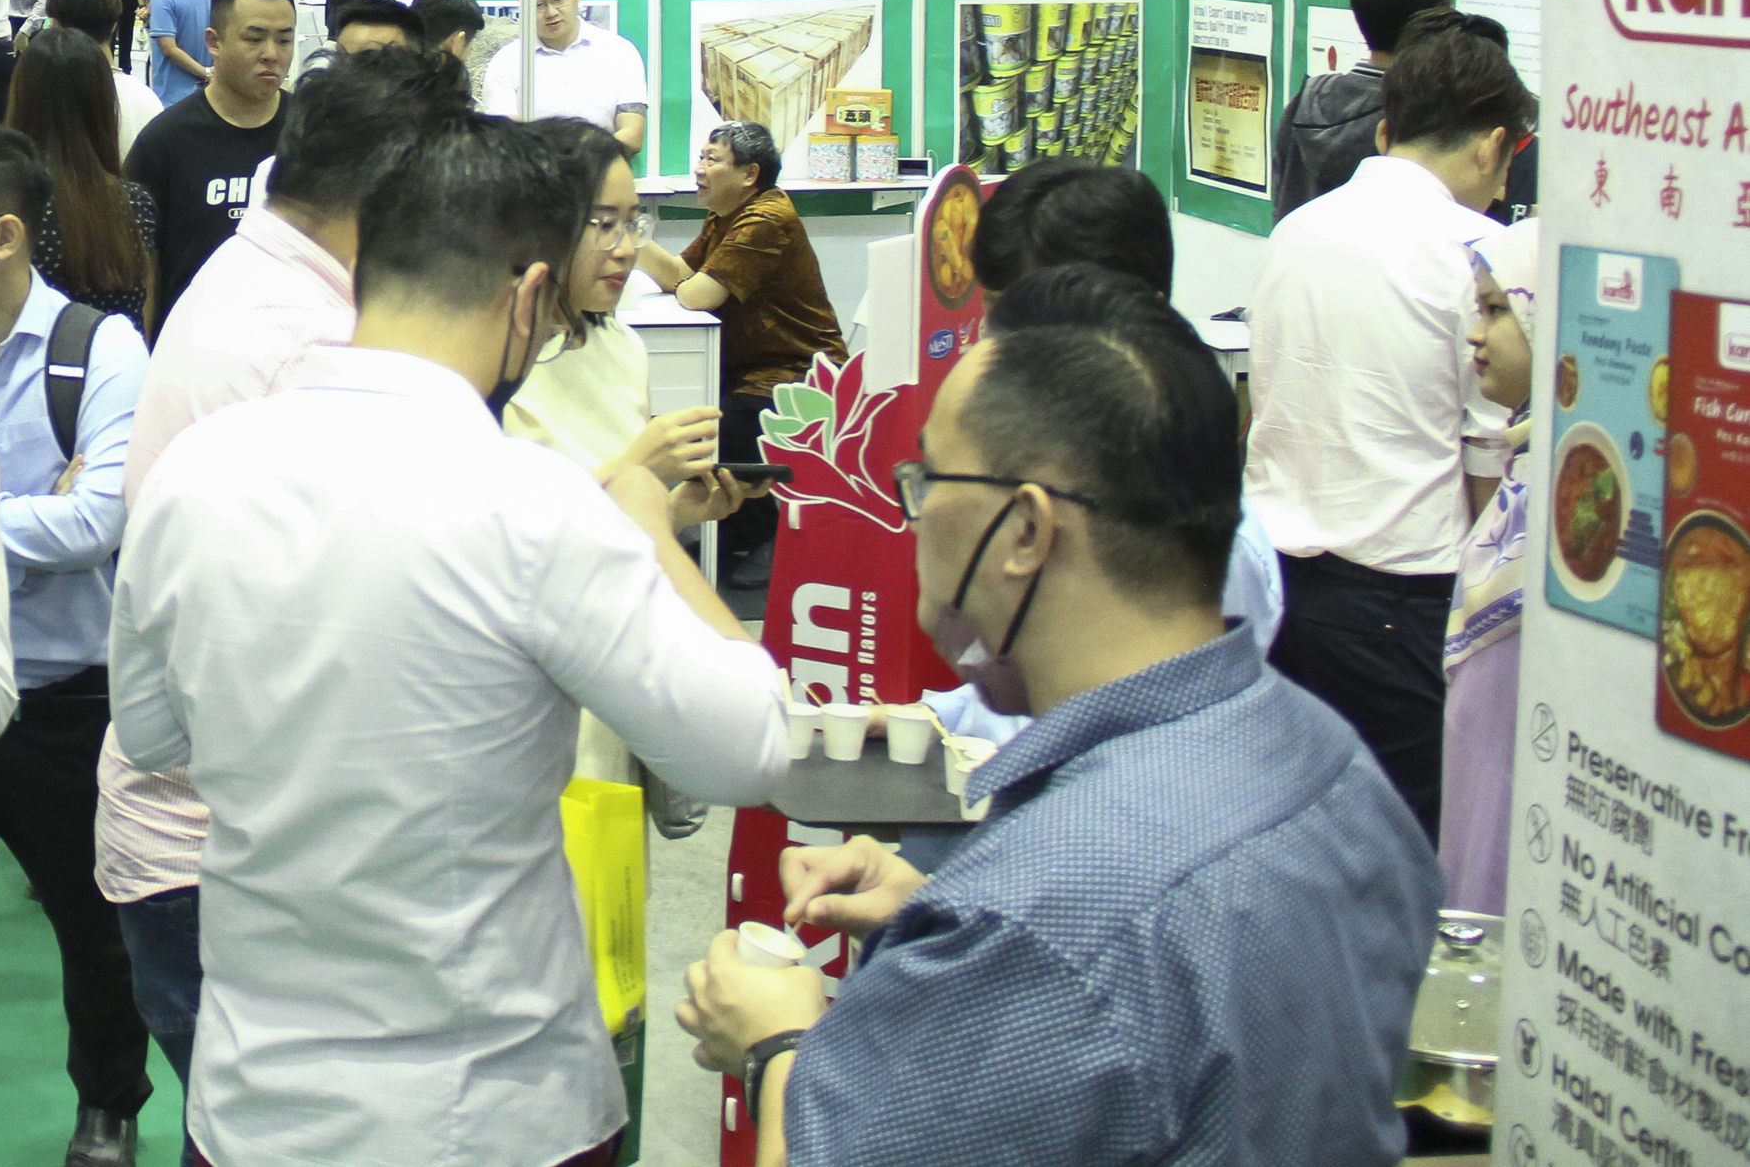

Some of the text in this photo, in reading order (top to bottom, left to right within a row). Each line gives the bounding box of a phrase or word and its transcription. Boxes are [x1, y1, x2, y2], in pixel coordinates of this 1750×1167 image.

[1562, 81, 1750, 153] Southeast A
[1694, 396, 1721, 417] Fish
[1568, 730, 1750, 857] Preservative Fr
[1562, 833, 1596, 881] No
[1602, 860, 1700, 948] Artificial
[1557, 940, 1626, 1014] Made
[1634, 999, 1682, 1057] with
[1552, 1053, 1612, 1126] Halal
